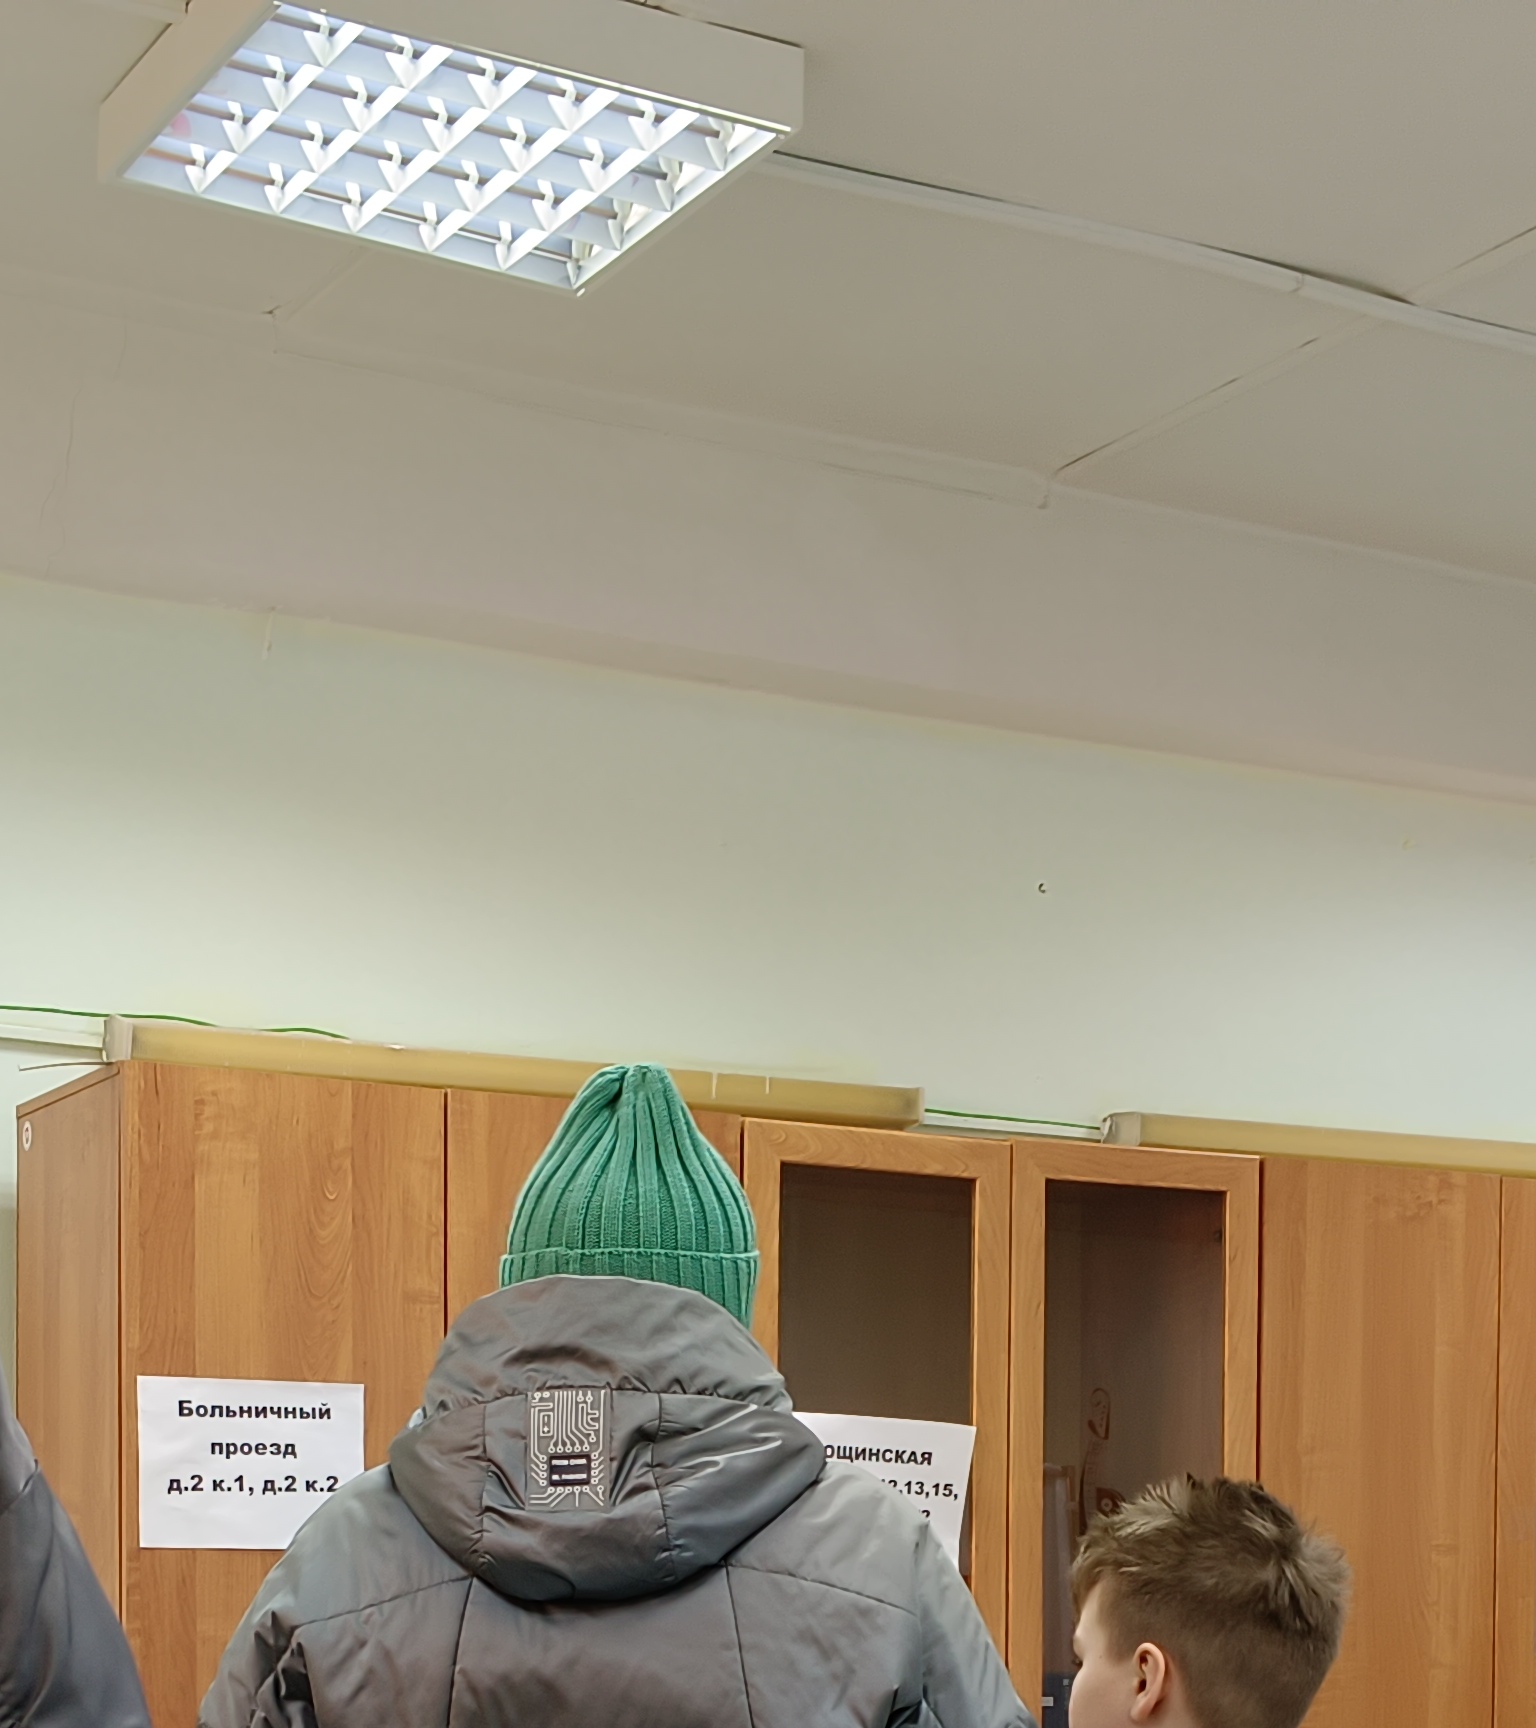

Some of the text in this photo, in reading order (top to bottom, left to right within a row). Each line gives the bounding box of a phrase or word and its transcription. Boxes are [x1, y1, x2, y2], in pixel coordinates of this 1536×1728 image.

[177, 1399, 332, 1420] Больничный
[210, 1442, 298, 1460] проезд
[824, 1444, 934, 1466] ОЩИНСКАЯ
[167, 1474, 340, 1496] д.2 к.1, д.2 к.2
